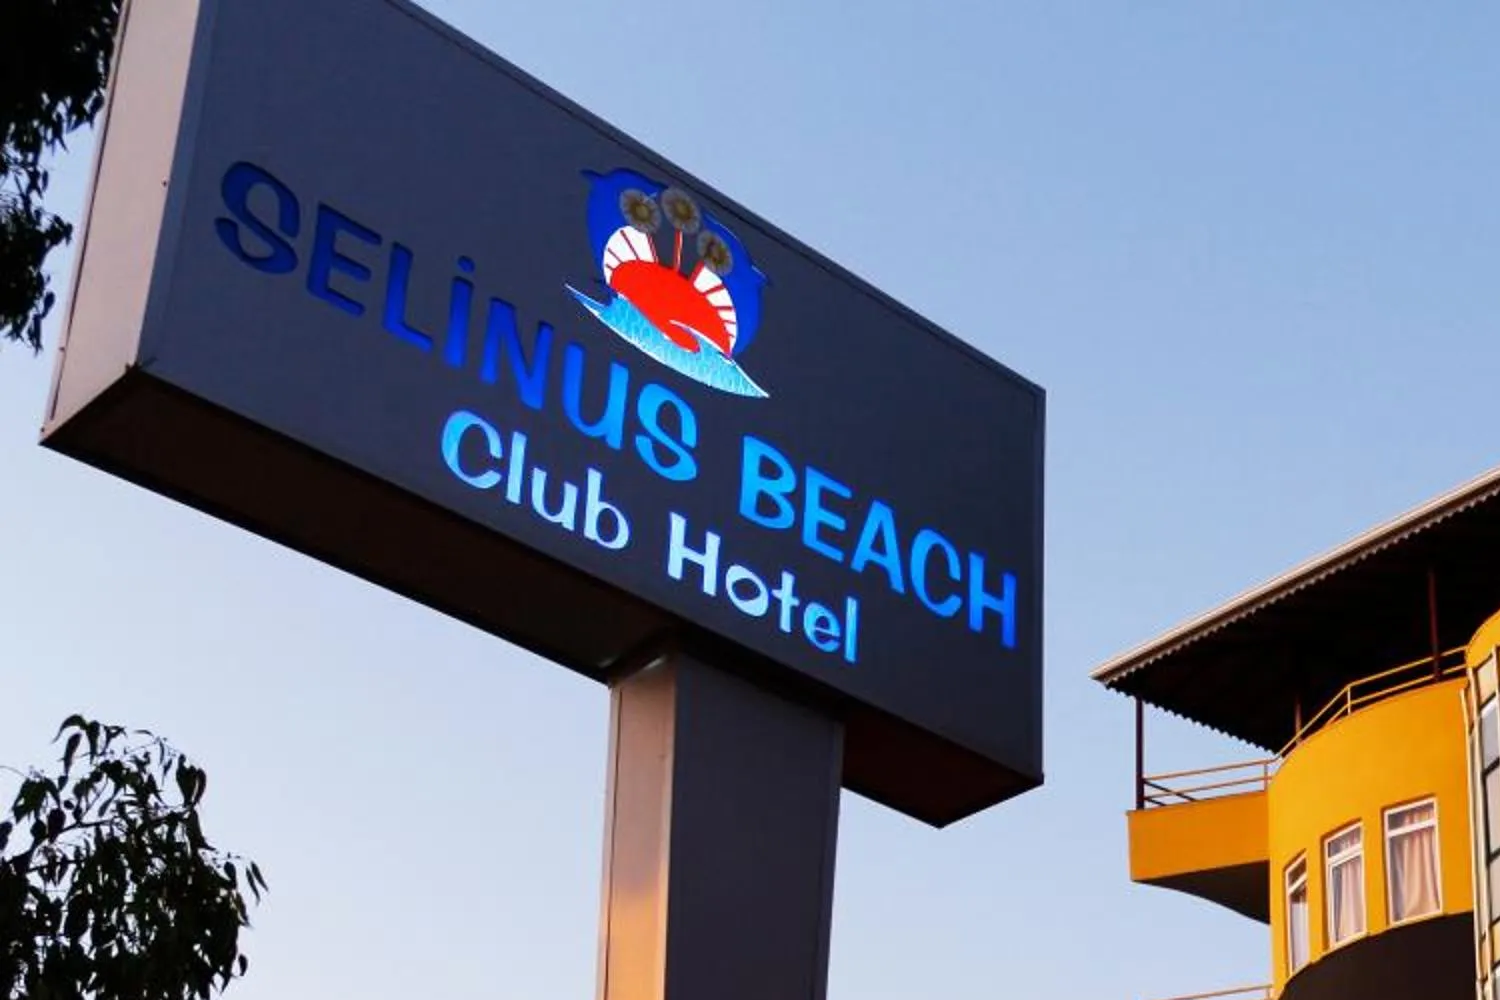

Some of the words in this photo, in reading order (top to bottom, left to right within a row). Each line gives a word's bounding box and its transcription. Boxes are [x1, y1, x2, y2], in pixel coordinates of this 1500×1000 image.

[440, 410, 632, 552] Club
[666, 513, 862, 664] Hotel
[739, 435, 1017, 650] BEACH
